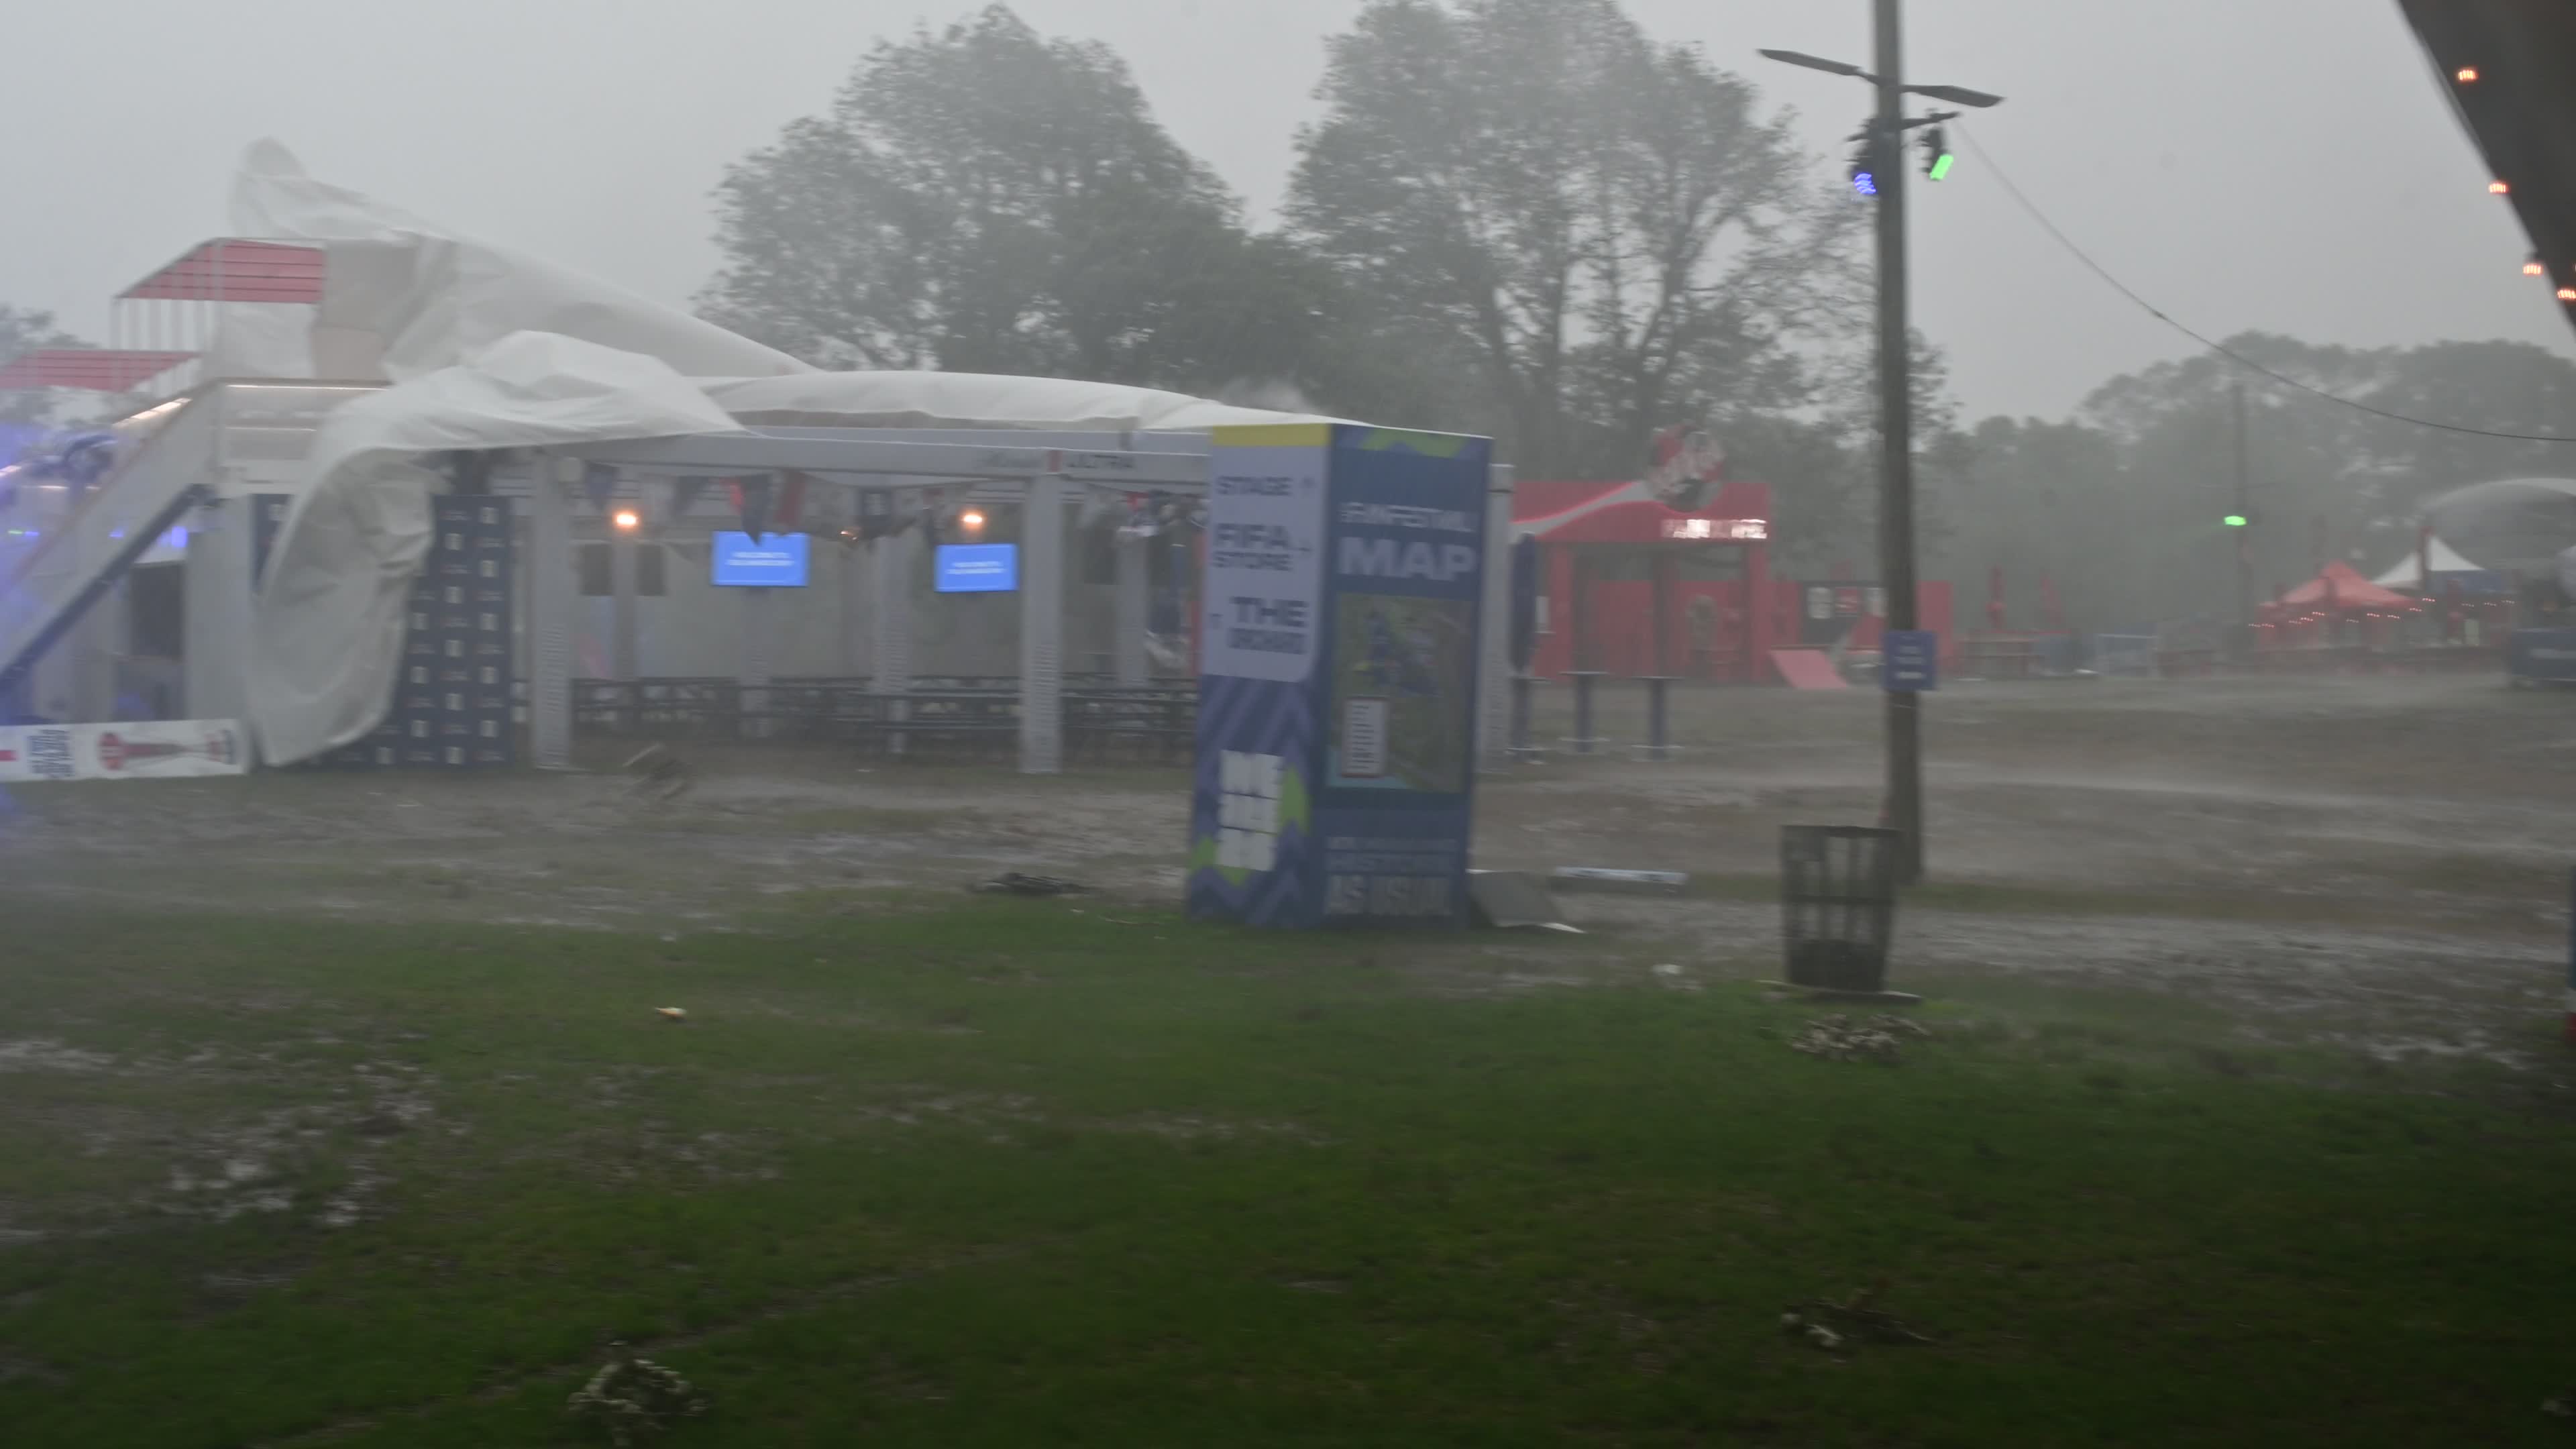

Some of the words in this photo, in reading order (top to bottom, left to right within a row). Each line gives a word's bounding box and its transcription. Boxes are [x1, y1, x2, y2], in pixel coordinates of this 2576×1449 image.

[1214, 523, 1291, 549] FIFA
[1337, 537, 1477, 581] MAP
[1228, 596, 1308, 627] THE
